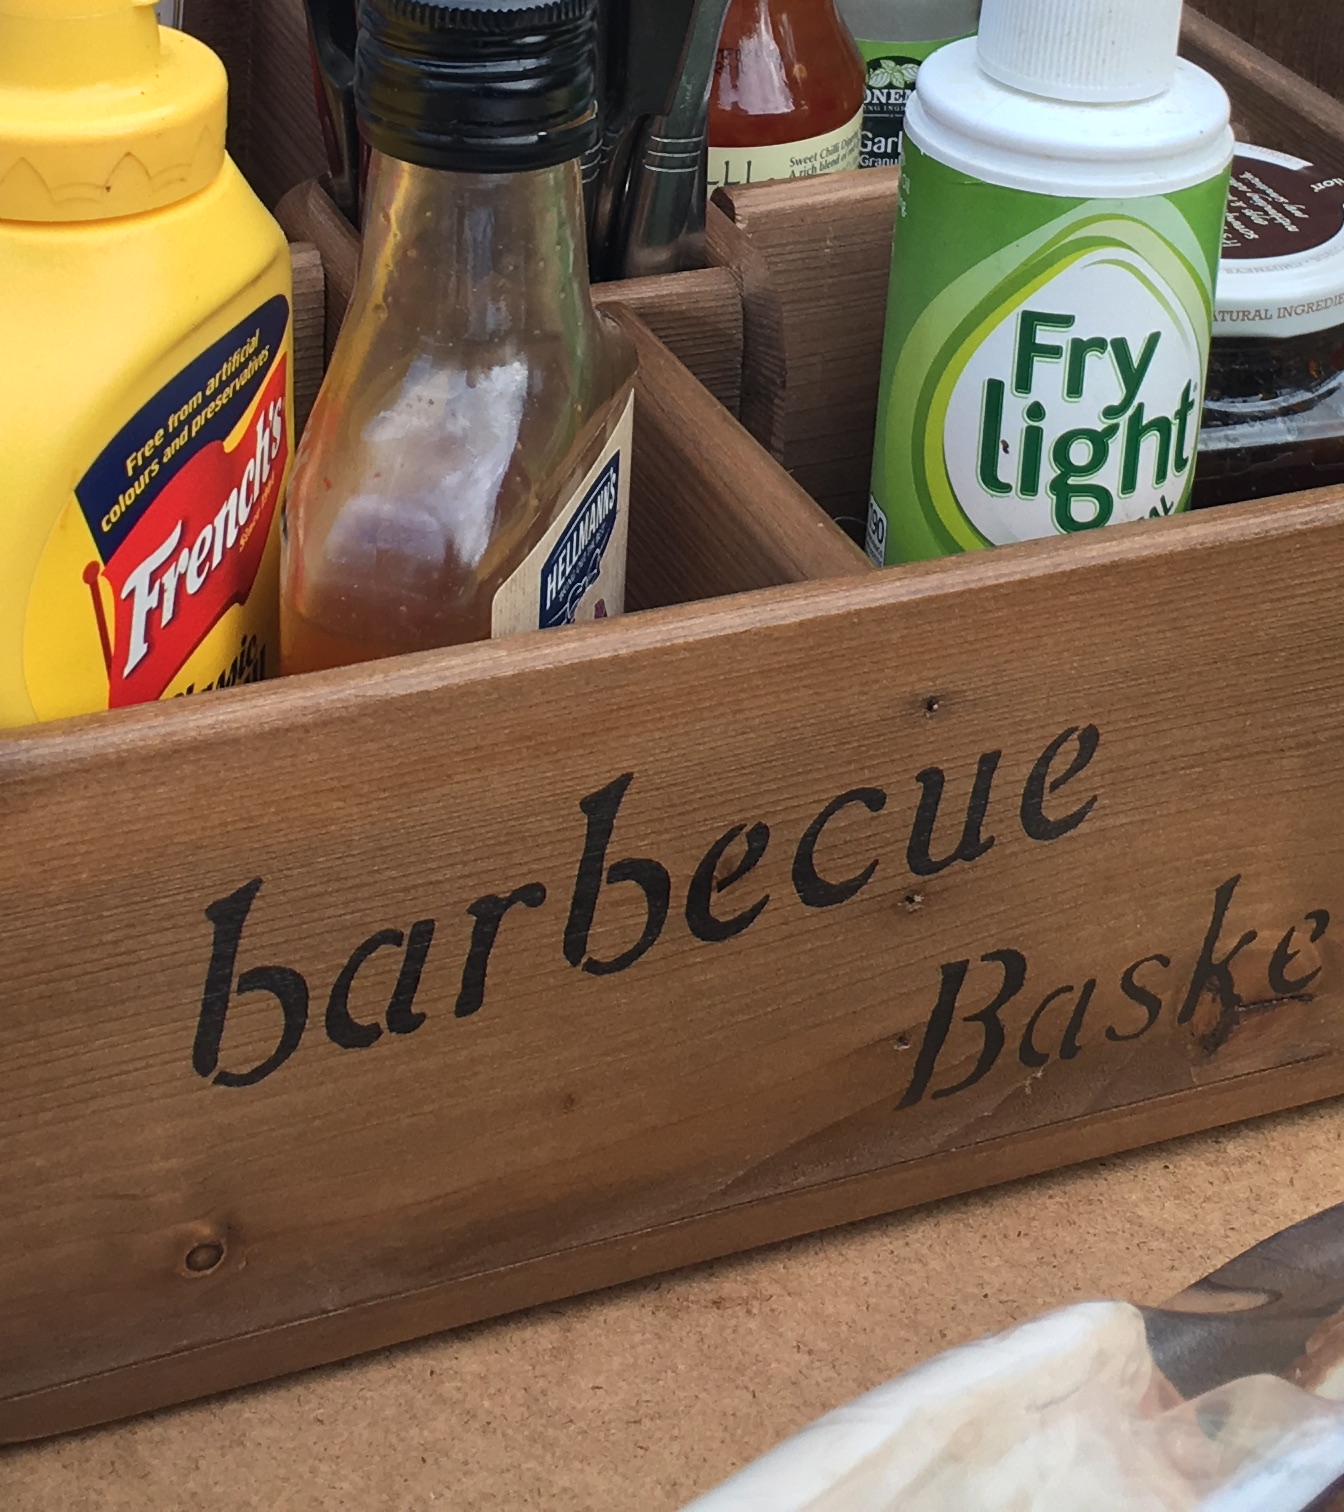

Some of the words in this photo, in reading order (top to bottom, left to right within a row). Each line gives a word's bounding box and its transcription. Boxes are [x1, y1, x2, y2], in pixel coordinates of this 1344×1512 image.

[789, 153, 818, 169] Sweet
[819, 142, 840, 159] Chilli
[101, 458, 160, 533] colours
[163, 425, 188, 463] and
[191, 345, 270, 438] preservatives
[125, 428, 164, 477] Free
[167, 390, 202, 433] from
[205, 327, 261, 396] artificial
[1011, 309, 1162, 422] Fry
[975, 377, 1197, 534] light
[121, 396, 282, 679] French's
[545, 468, 617, 610] HELLMANN'S
[190, 723, 1104, 1089] barbecue
